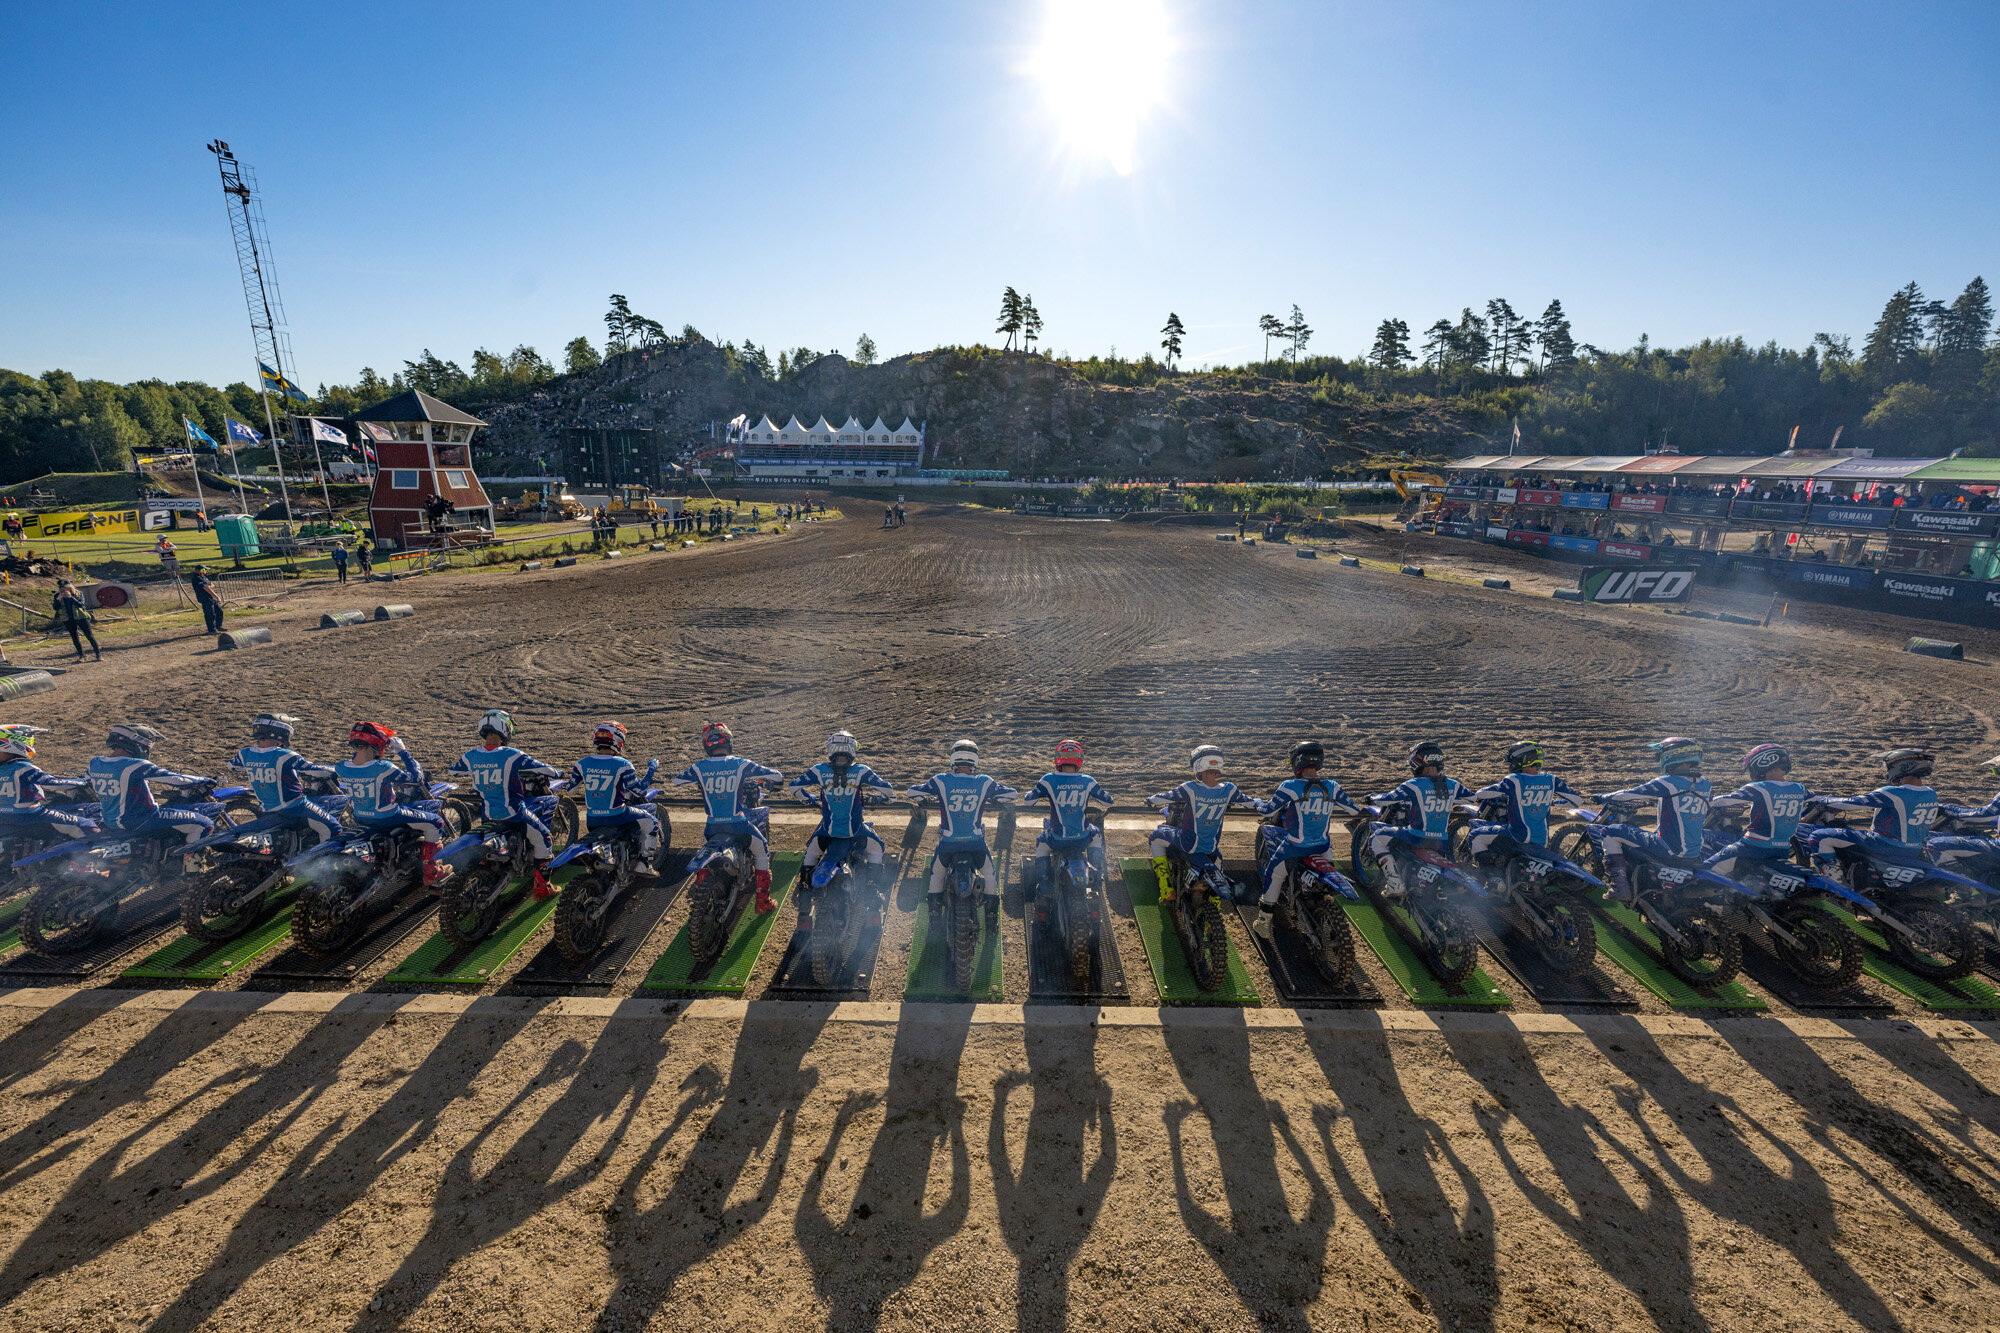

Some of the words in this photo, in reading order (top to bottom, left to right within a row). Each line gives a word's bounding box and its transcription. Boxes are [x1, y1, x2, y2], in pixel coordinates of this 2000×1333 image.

[1621, 497, 1656, 505] Beta
[43, 511, 136, 536] GAERNE
[1838, 511, 1873, 521] YAMAHA
[1911, 513, 1981, 526] Kawasaki
[1917, 522, 1946, 531] Racing
[1605, 545, 1642, 556] Beta
[1594, 571, 1694, 600] UFO
[1813, 573, 1850, 584] YAMAHA
[1883, 579, 1956, 596] Kawasaki
[1889, 588, 1919, 598] Racing
[1920, 592, 1944, 600] Team
[246, 767, 277, 783] 548
[472, 768, 502, 785] 114
[585, 774, 614, 791] 57
[705, 775, 738, 794] 490
[948, 794, 979, 813] 33
[1055, 790, 1087, 807] 441
[1522, 790, 1553, 807] 344
[158, 811, 197, 820] YAMAHA
[1195, 802, 1227, 820] 717
[1907, 807, 1939, 826] 39
[1525, 860, 1549, 877] 344
[1657, 867, 1687, 884] 236
[1882, 866, 1917, 883] 39
